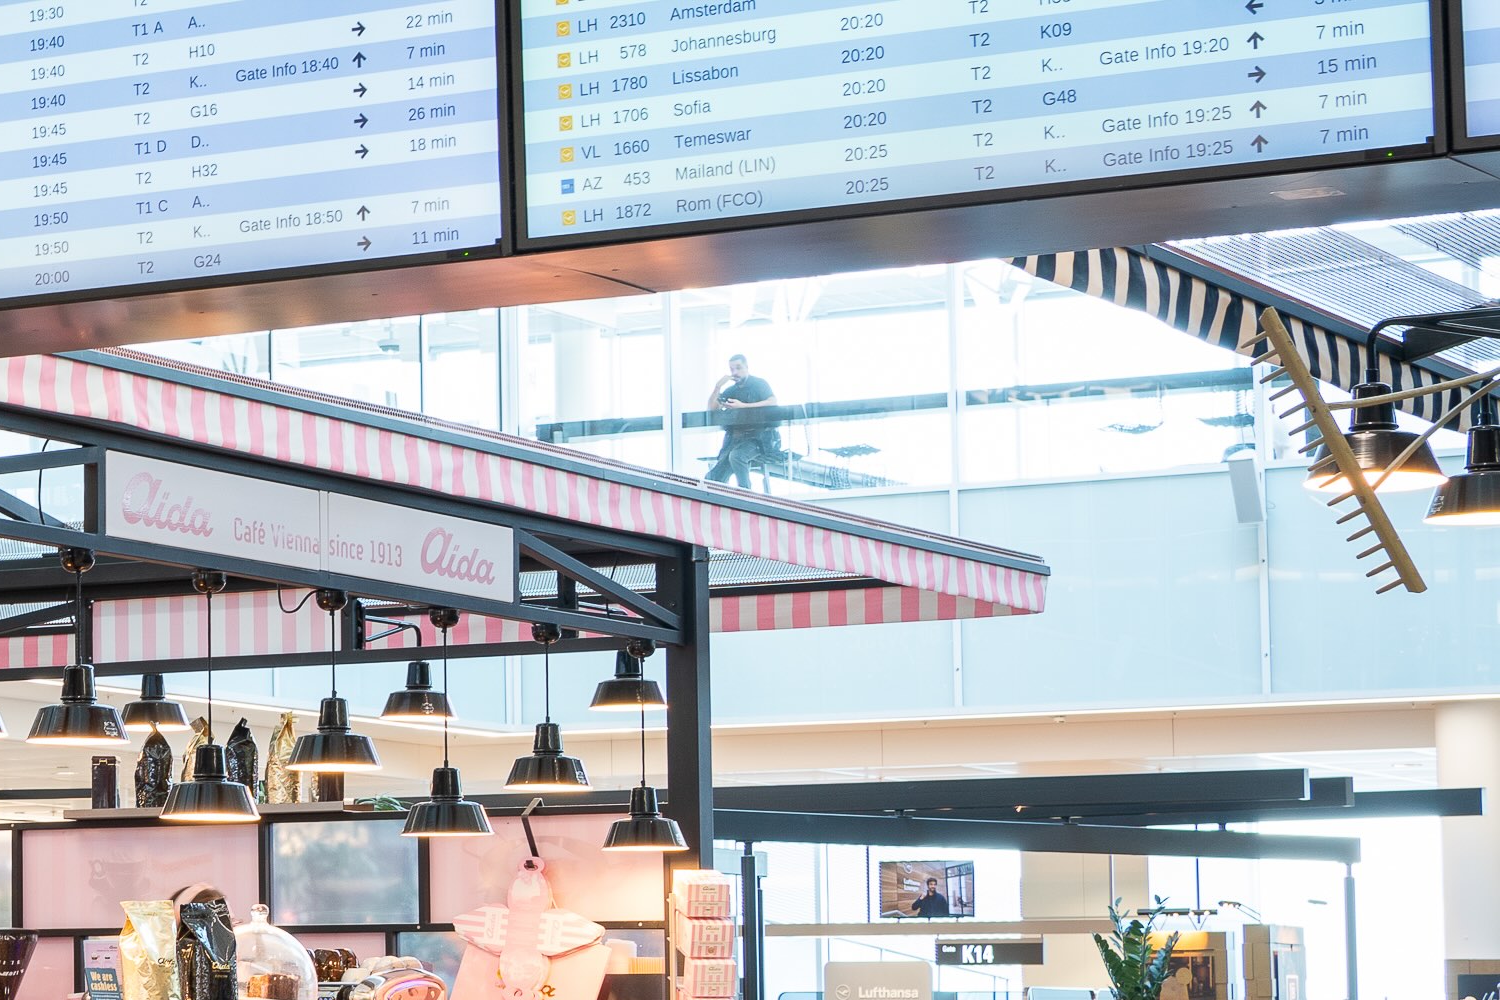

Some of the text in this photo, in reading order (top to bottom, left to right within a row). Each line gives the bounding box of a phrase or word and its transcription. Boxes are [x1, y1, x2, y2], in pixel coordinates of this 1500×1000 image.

[31, 35, 64, 51] 19:40
[132, 23, 148, 36] T1
[154, 21, 163, 34] A
[32, 94, 66, 110] 19:40
[134, 82, 149, 96] T2
[236, 68, 267, 82] Gate
[272, 62, 297, 77] Info
[302, 57, 339, 74] 18:40
[407, 46, 415, 59] 7
[420, 45, 445, 58] min
[580, 22, 1071, 96] LH 1780 Lissabon 20:20 T2 K09
[581, 57, 1377, 159] VL 1660 Temeswar 20:20 T2 G48 15 min
[35, 270, 69, 285] 20:00
[137, 261, 154, 274] T2
[194, 254, 221, 268] G24
[413, 231, 428, 245] 11
[434, 230, 459, 242] min
[233, 516, 265, 545] Café
[271, 523, 320, 554] Vienna
[329, 532, 363, 561] since
[370, 540, 402, 568] 1913
[961, 944, 994, 964] K14
[90, 971, 113, 982] We are
[90, 980, 117, 992] cashless
[858, 986, 919, 999] Lufthansa
